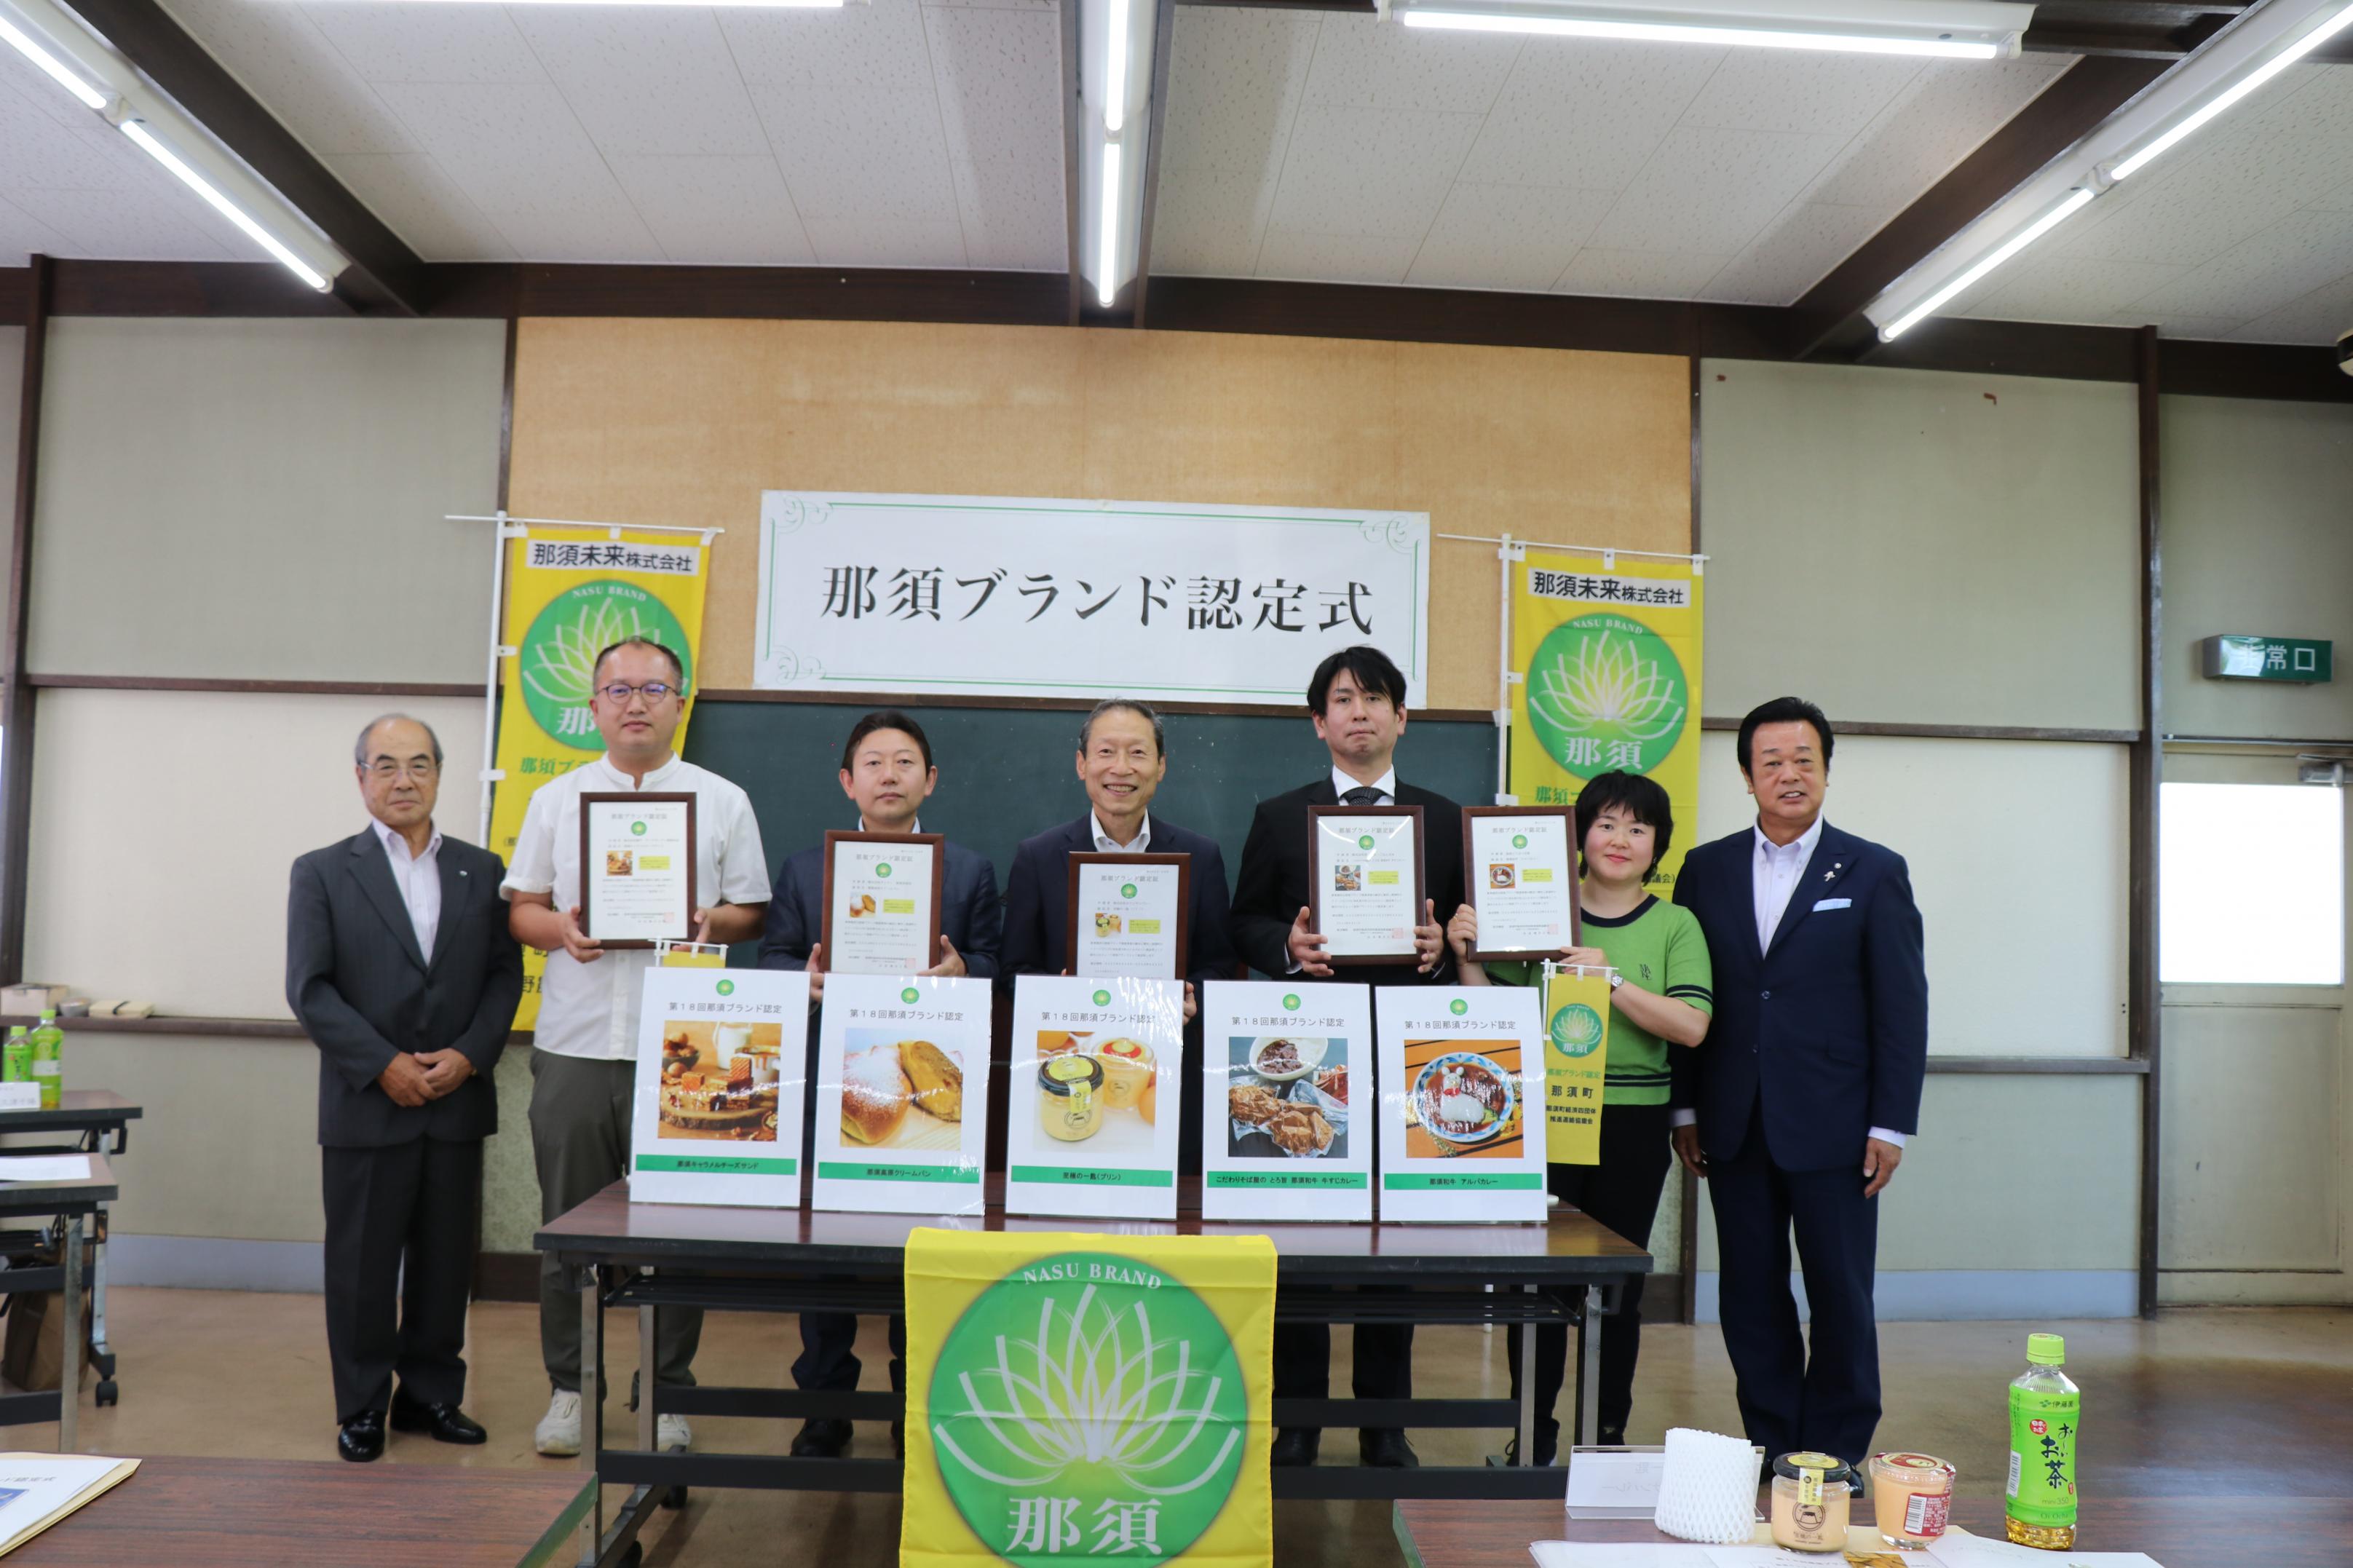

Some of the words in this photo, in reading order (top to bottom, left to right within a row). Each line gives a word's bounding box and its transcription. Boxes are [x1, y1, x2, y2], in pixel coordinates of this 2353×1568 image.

[533, 542, 693, 572] 那須未来株式会社
[572, 585, 604, 599] NASU
[608, 585, 647, 602] BRAND
[820, 565, 1374, 636] 那須ブランド認定式
[1533, 571, 1685, 605] 那須未来株式会社
[1573, 619, 1602, 630] NASU
[1605, 619, 1643, 635] BRAND
[556, 706, 597, 736] 那
[1565, 736, 1643, 770] 那須
[1562, 1043, 1589, 1054] 那須
[1551, 1085, 1594, 1099] 那須町
[1024, 1262, 1080, 1286] NASU
[1088, 1263, 1162, 1289] BRAND
[2040, 1435, 2068, 1489] お茶
[1005, 1495, 1163, 1556] 那須
